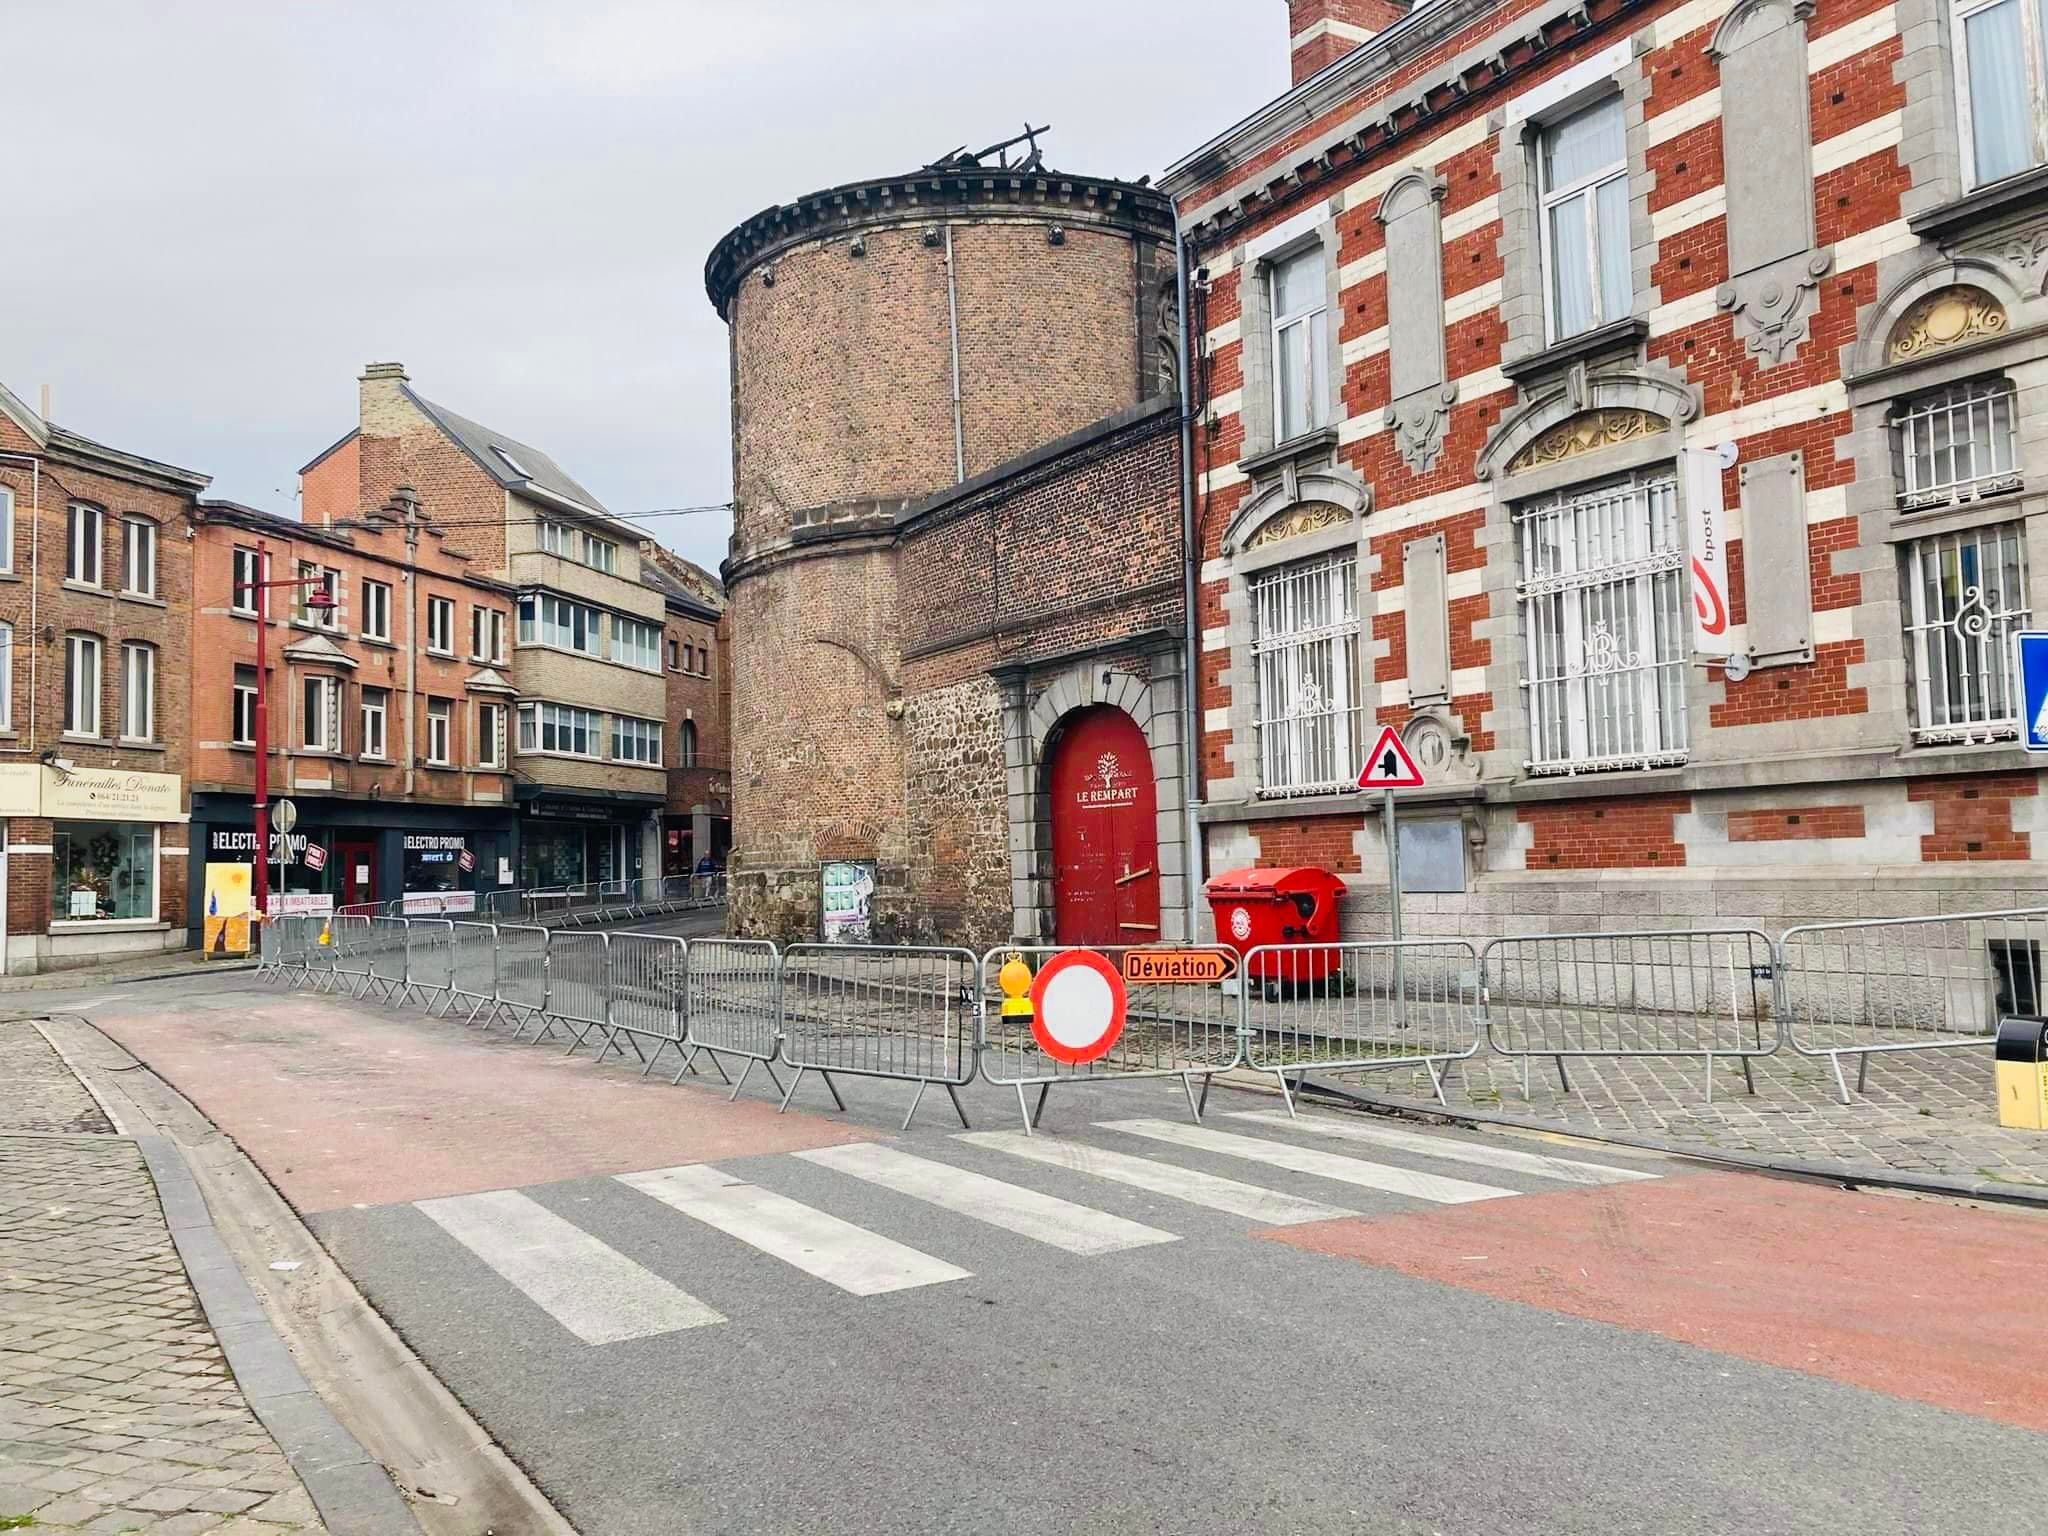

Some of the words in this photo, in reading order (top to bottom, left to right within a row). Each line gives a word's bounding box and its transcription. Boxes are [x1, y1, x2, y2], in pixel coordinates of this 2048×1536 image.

[1702, 509, 1716, 561] bpost
[53, 771, 122, 790] Funérailles
[1076, 792, 1089, 803] LE
[1090, 787, 1138, 802] REMPART
[407, 836, 438, 850] ELECTRO
[439, 837, 465, 850] PROMO
[1130, 956, 1217, 977] Déviation
